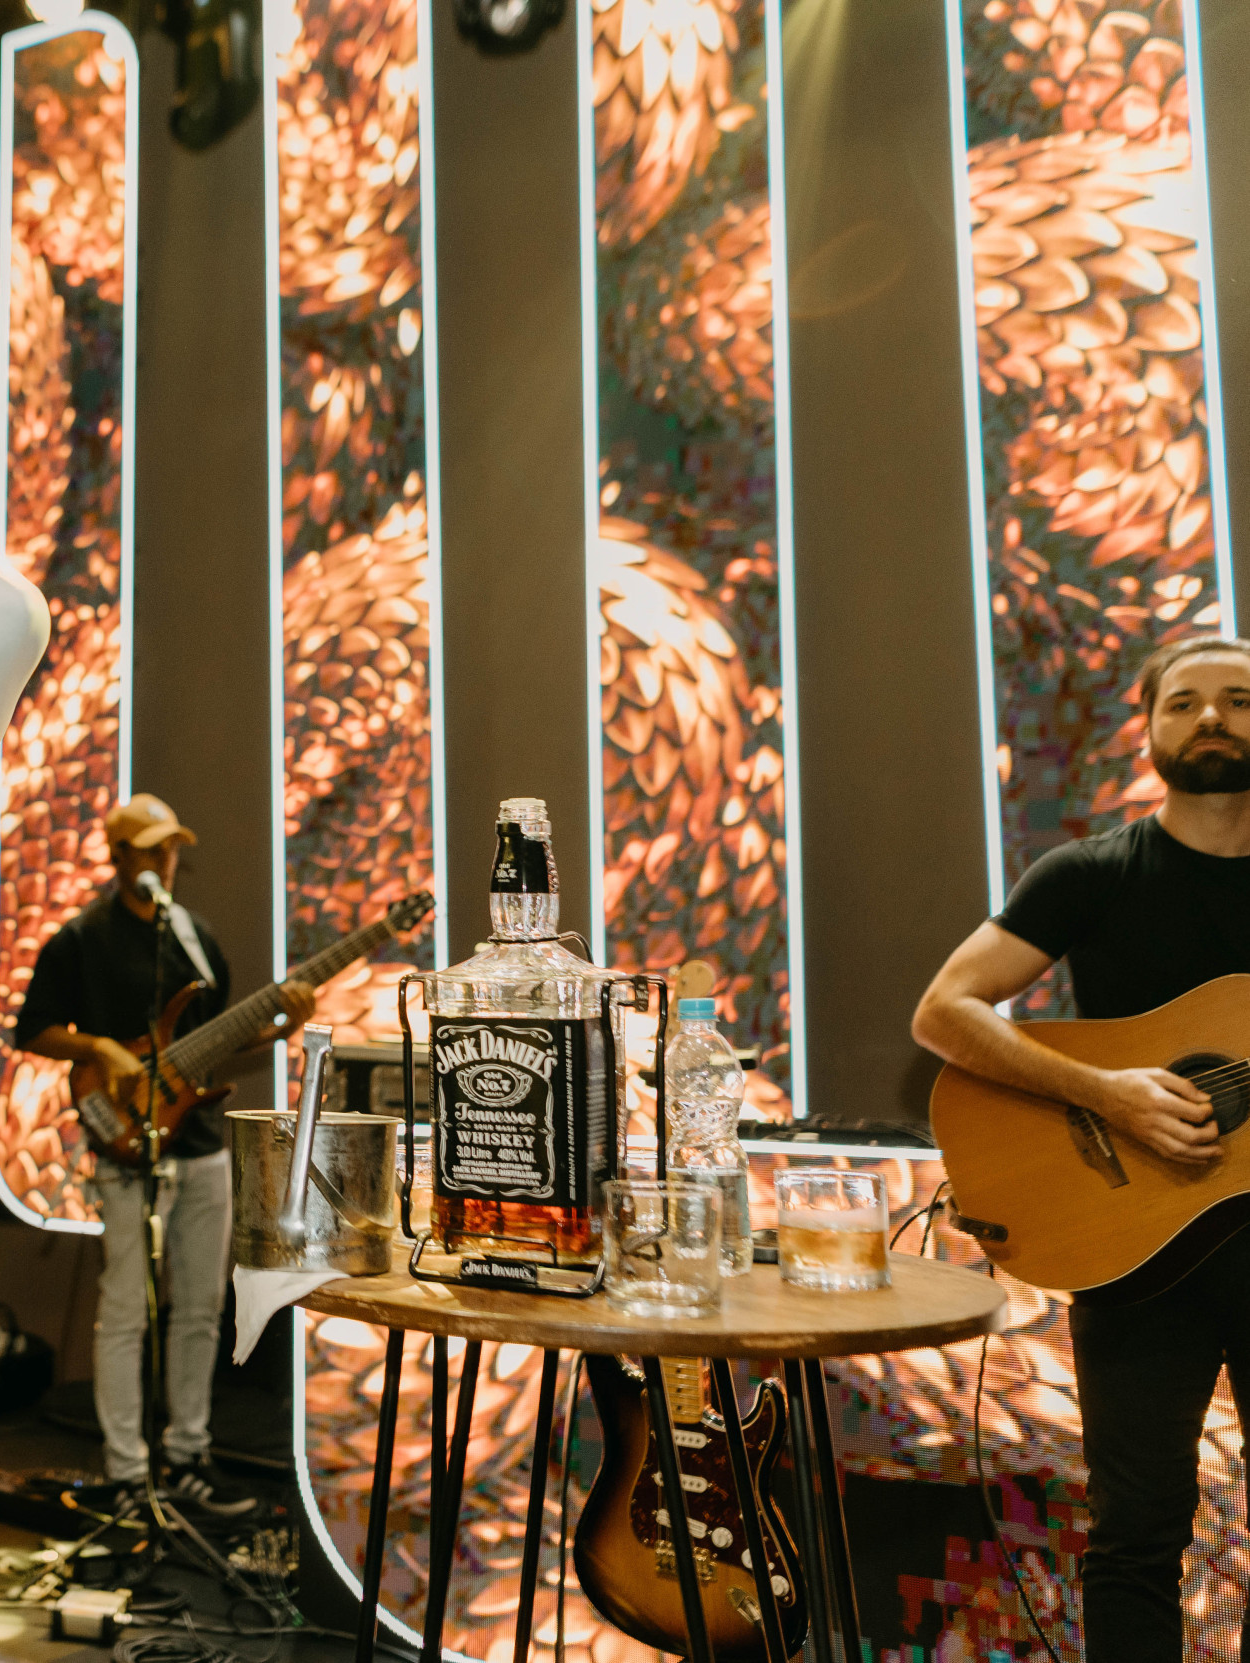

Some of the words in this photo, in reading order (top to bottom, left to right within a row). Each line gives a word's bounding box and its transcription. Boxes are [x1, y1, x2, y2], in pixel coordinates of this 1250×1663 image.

[435, 1037, 481, 1075] JACK
[479, 1029, 558, 1080] DANIEL'S
[454, 1102, 536, 1125] Tennessee
[456, 1130, 536, 1149] WHISKEY
[497, 1148, 519, 1162] 40%
